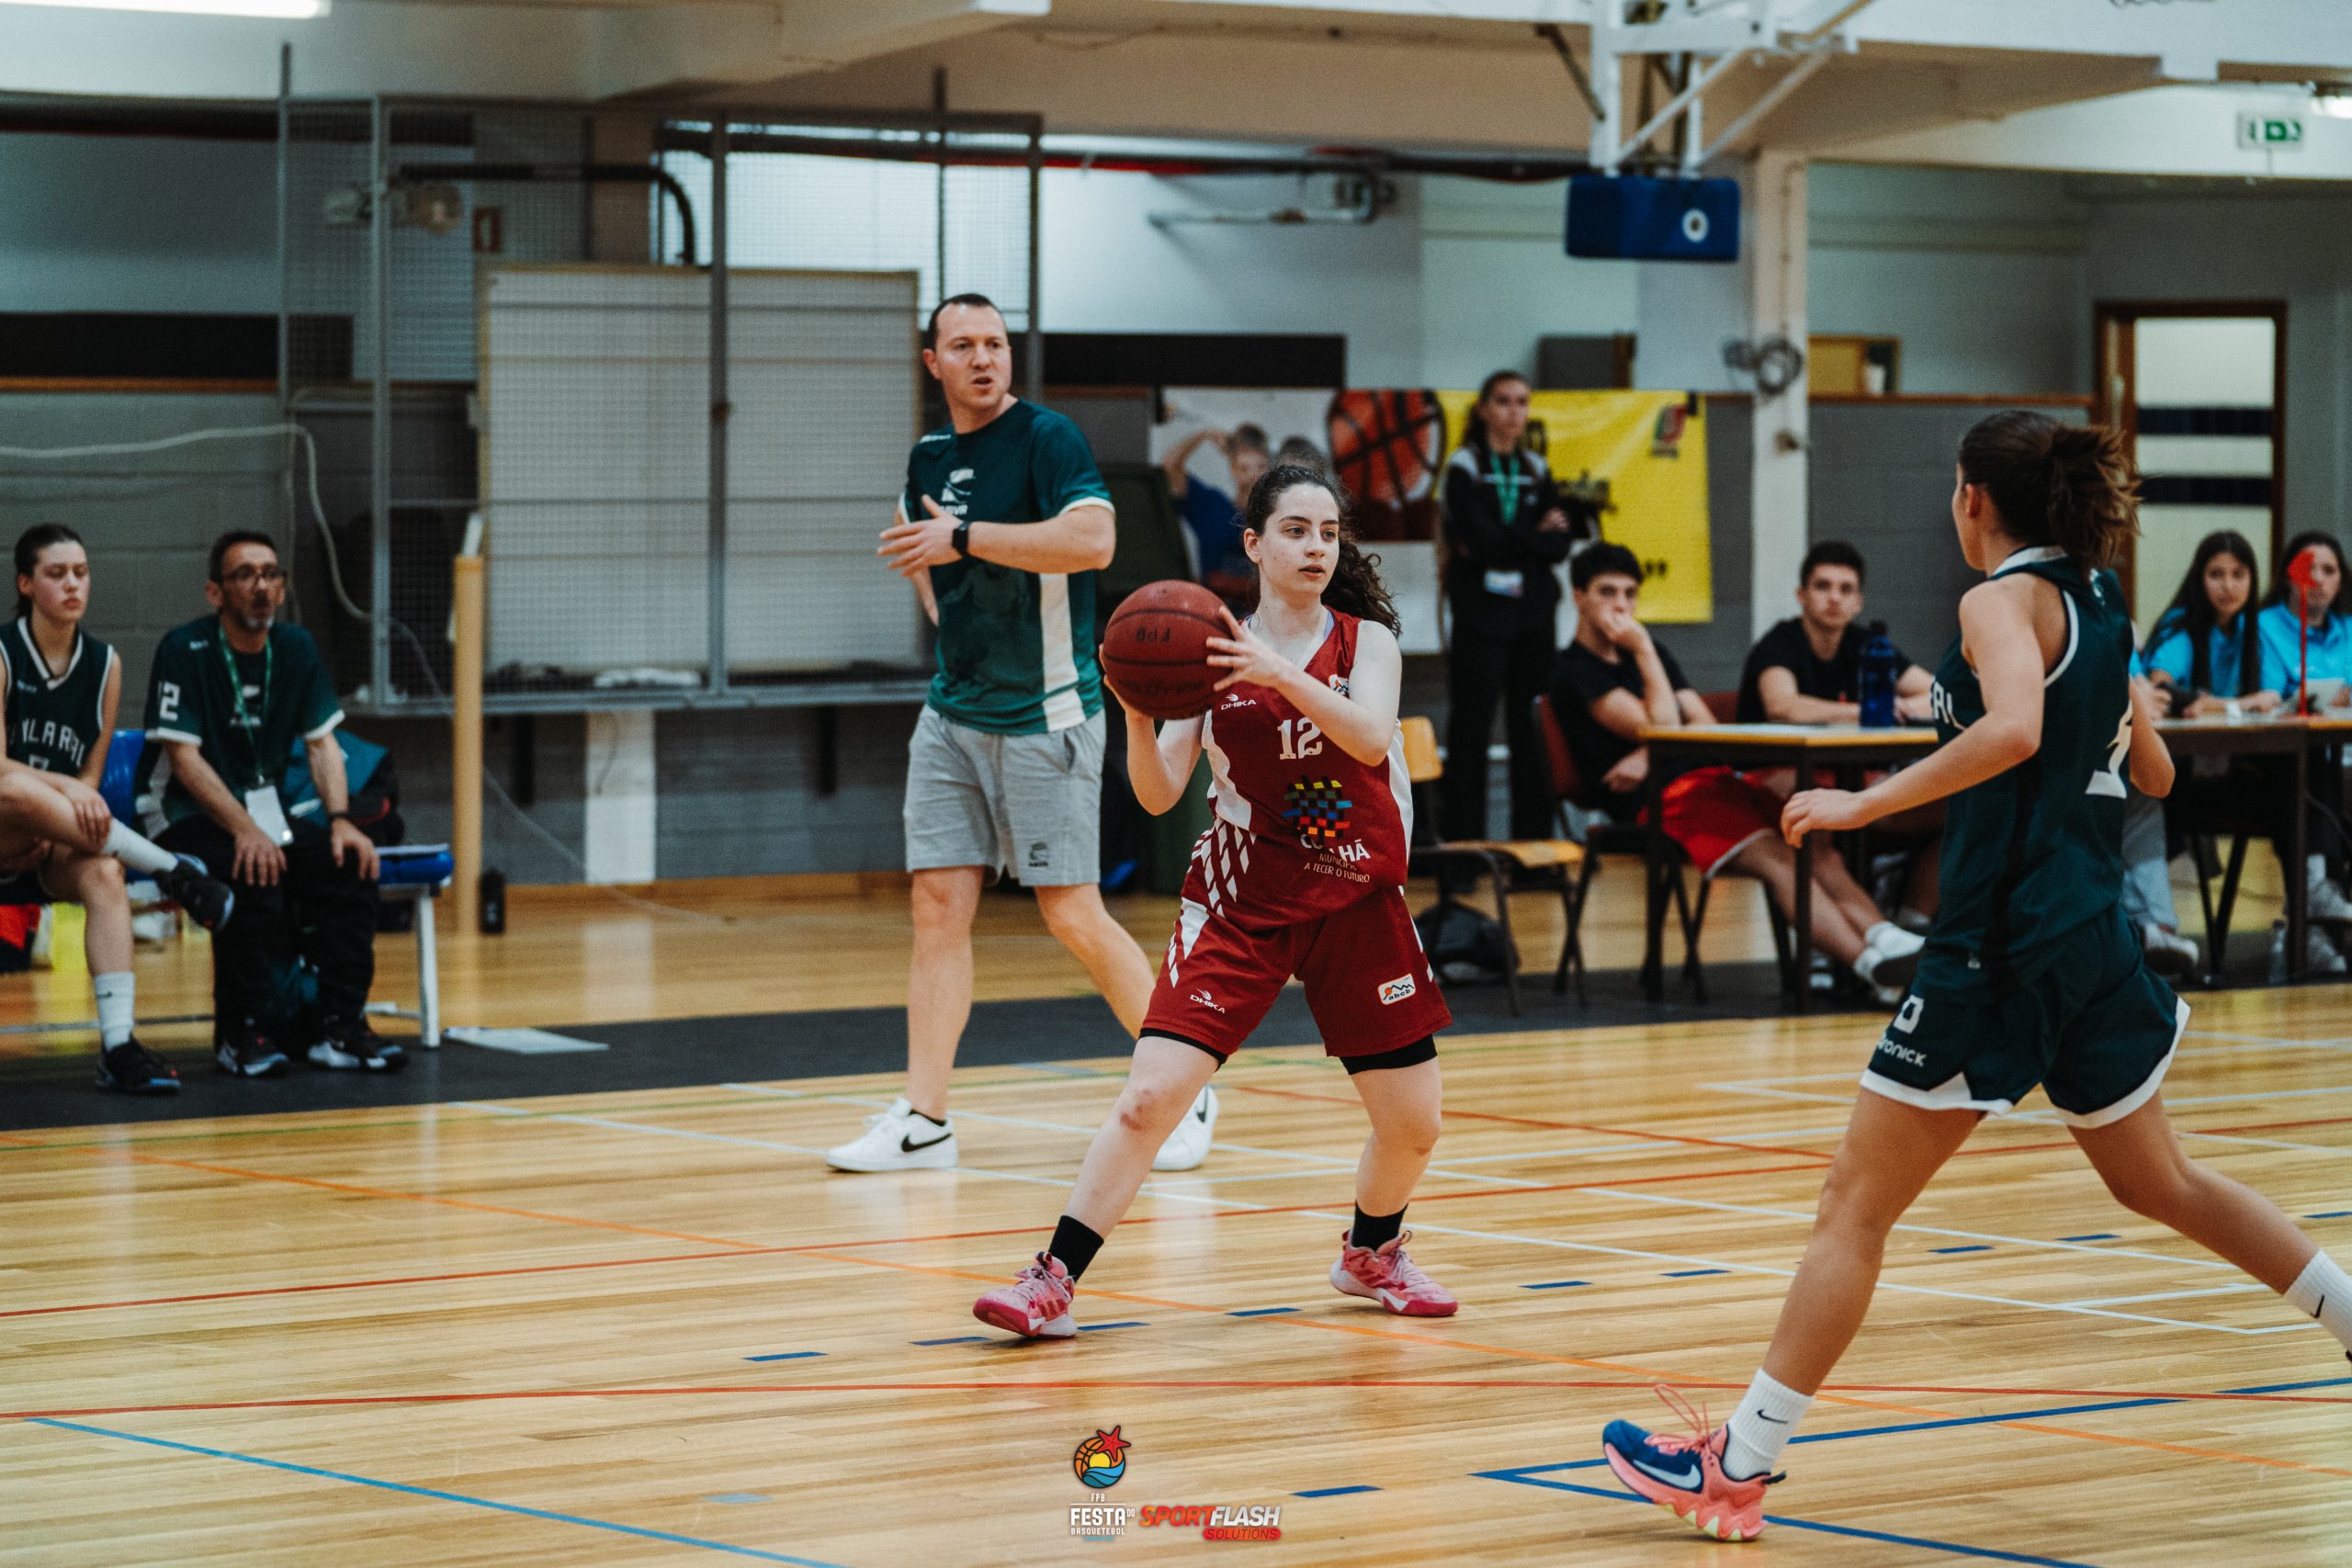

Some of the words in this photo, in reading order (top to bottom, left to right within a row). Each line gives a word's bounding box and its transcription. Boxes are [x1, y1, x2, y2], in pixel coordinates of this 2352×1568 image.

[1220, 699, 1257, 710] DHIKA
[1277, 716, 1323, 761] 12
[1313, 863, 1334, 875] TECER
[1336, 869, 1343, 877] O
[1343, 871, 1371, 883] FUTURO
[1190, 994, 1226, 1014] DHIKA
[1388, 989, 1411, 1000] abcb
